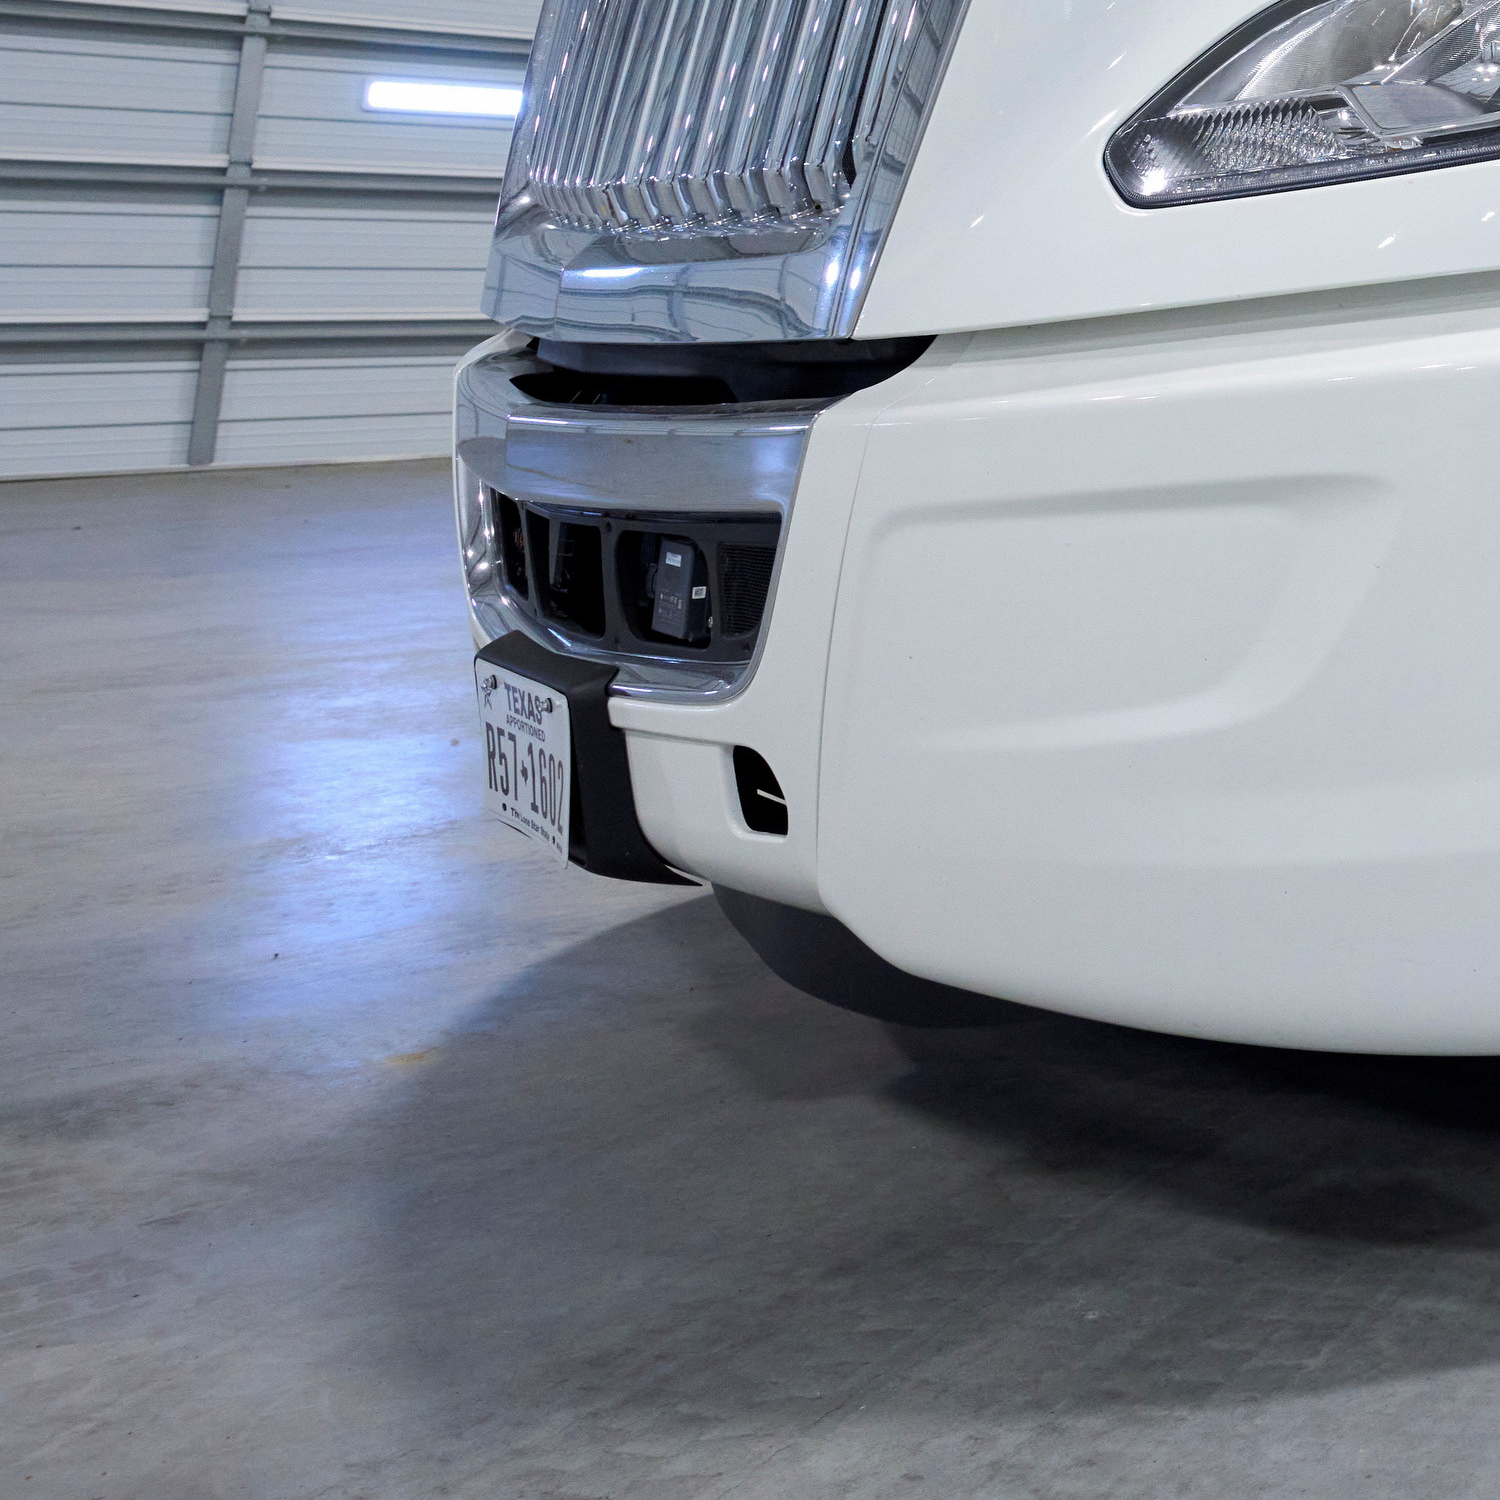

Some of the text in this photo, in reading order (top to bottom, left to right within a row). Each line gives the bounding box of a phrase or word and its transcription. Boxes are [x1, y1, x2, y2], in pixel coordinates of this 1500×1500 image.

[504, 681, 543, 725] TEXAS
[506, 714, 545, 743] APPORTIONED
[486, 721, 564, 836] R57 1602
